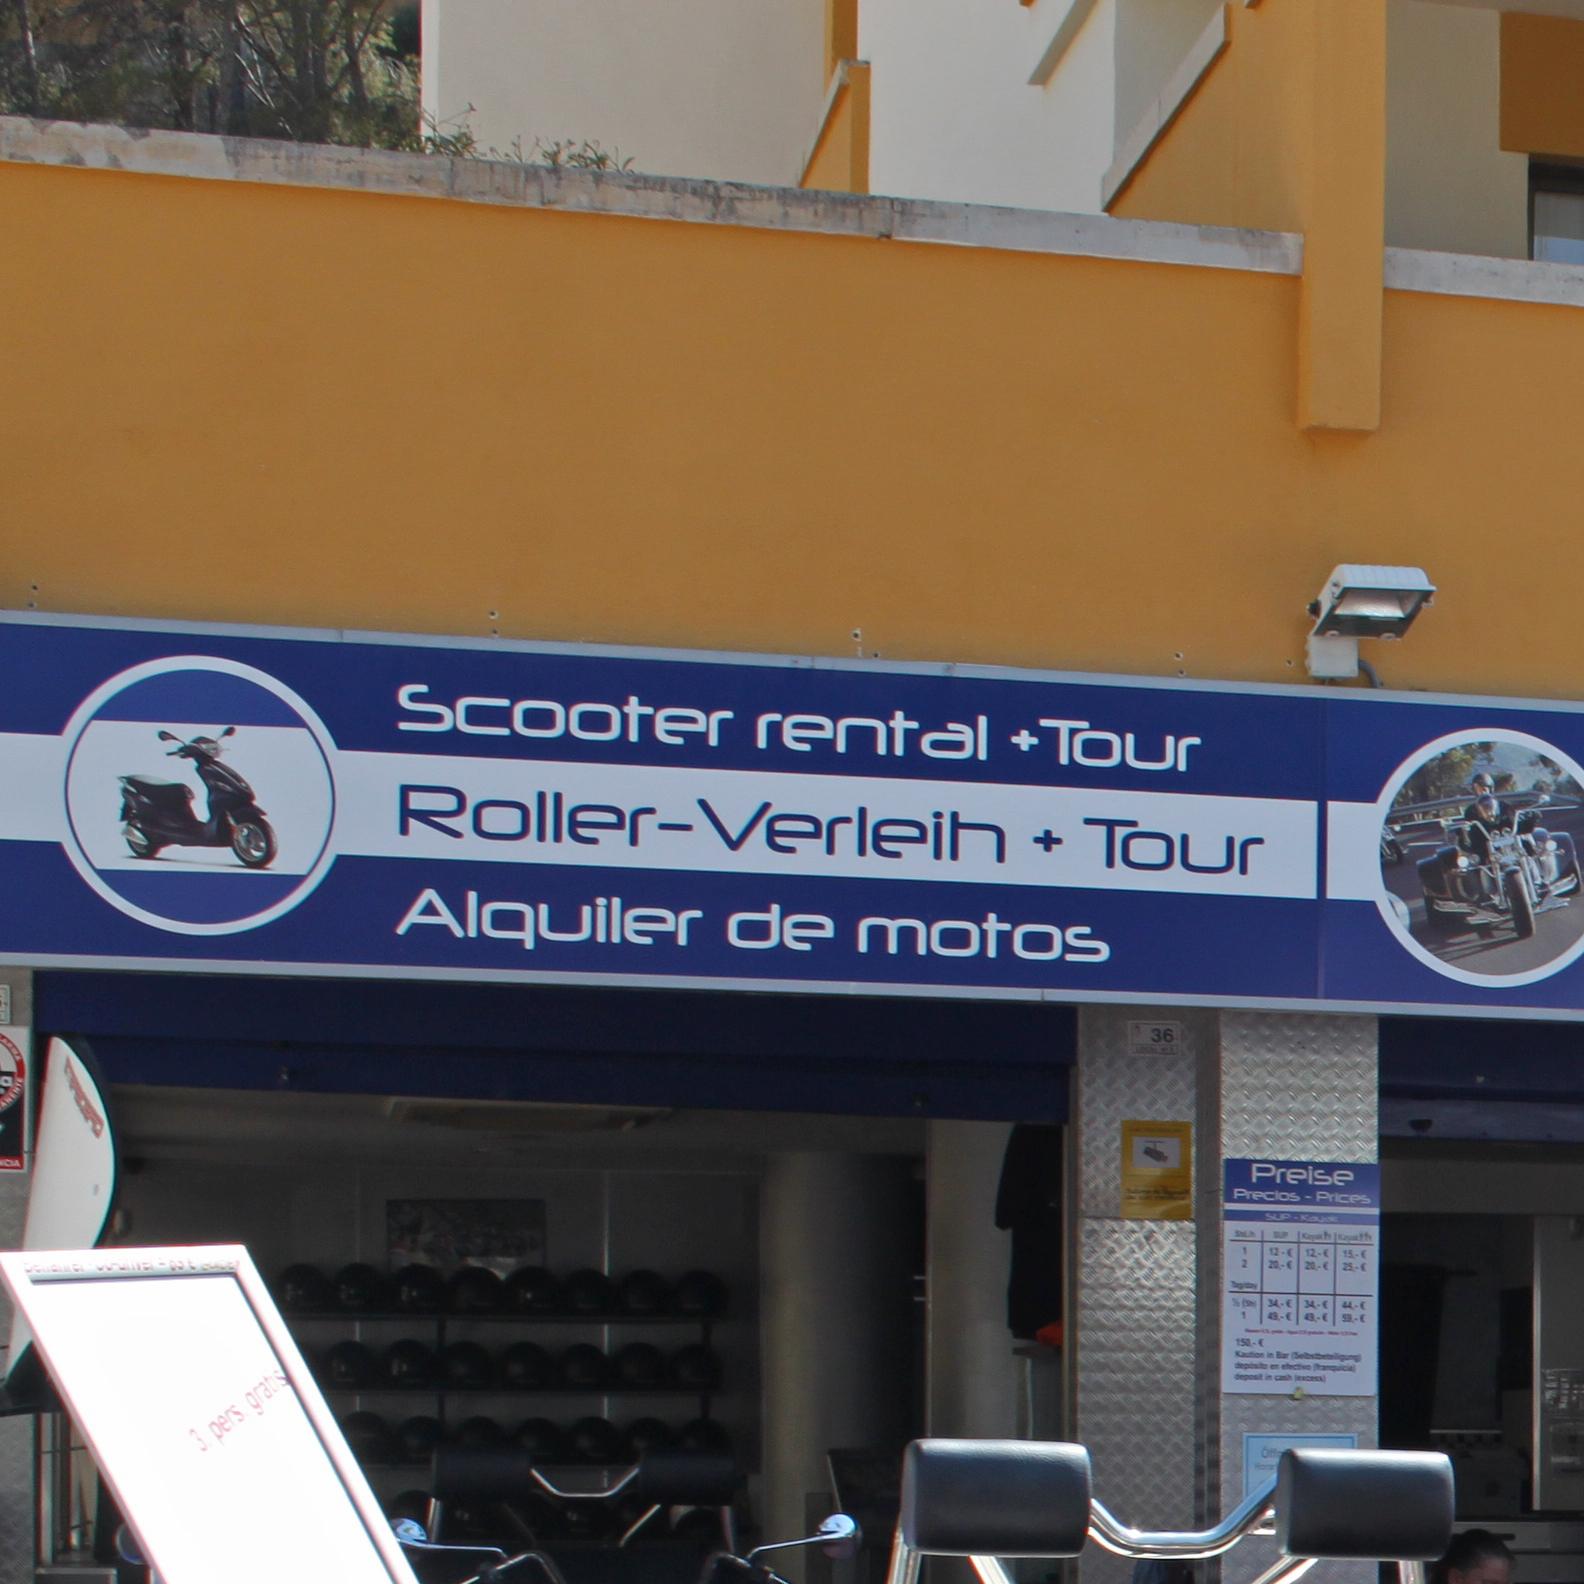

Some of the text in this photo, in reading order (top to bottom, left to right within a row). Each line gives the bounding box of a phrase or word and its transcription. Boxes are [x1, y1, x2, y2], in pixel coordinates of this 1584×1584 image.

[396, 683, 733, 750] Scooter
[757, 710, 988, 763] rental
[398, 783, 1006, 864] Roller-Verleih
[1083, 817, 1264, 877] Tour
[395, 887, 1110, 963] Alquiler de motos
[1151, 1028, 1175, 1043] 36
[1233, 1188, 1371, 1205] Precios Prices
[1251, 1164, 1354, 1186] Preise
[244, 1370, 292, 1416] gratis
